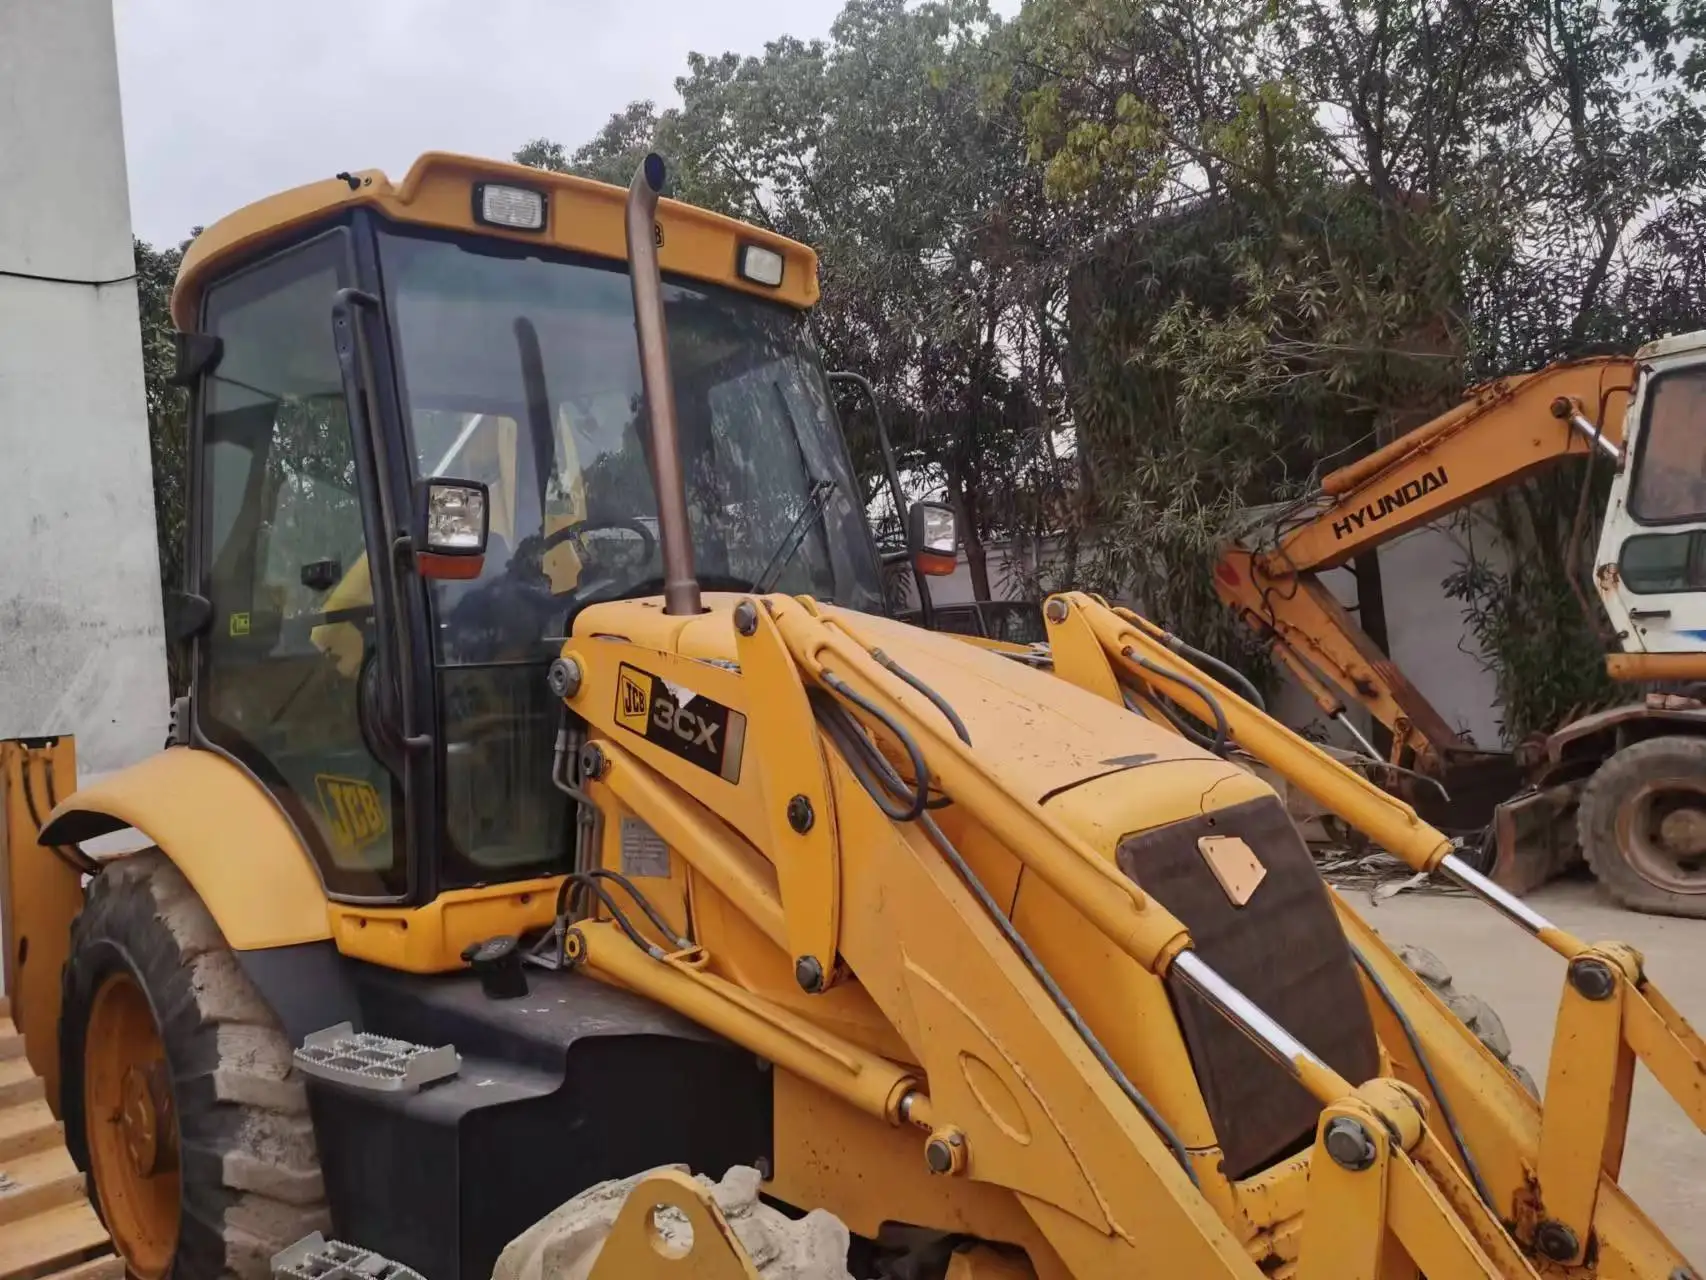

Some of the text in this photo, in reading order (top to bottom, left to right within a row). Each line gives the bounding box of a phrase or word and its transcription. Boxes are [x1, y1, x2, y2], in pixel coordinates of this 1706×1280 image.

[1332, 465, 1448, 540] HYUNDAI
[625, 682, 720, 754] JCB 3CX
[326, 781, 382, 847] JCB
